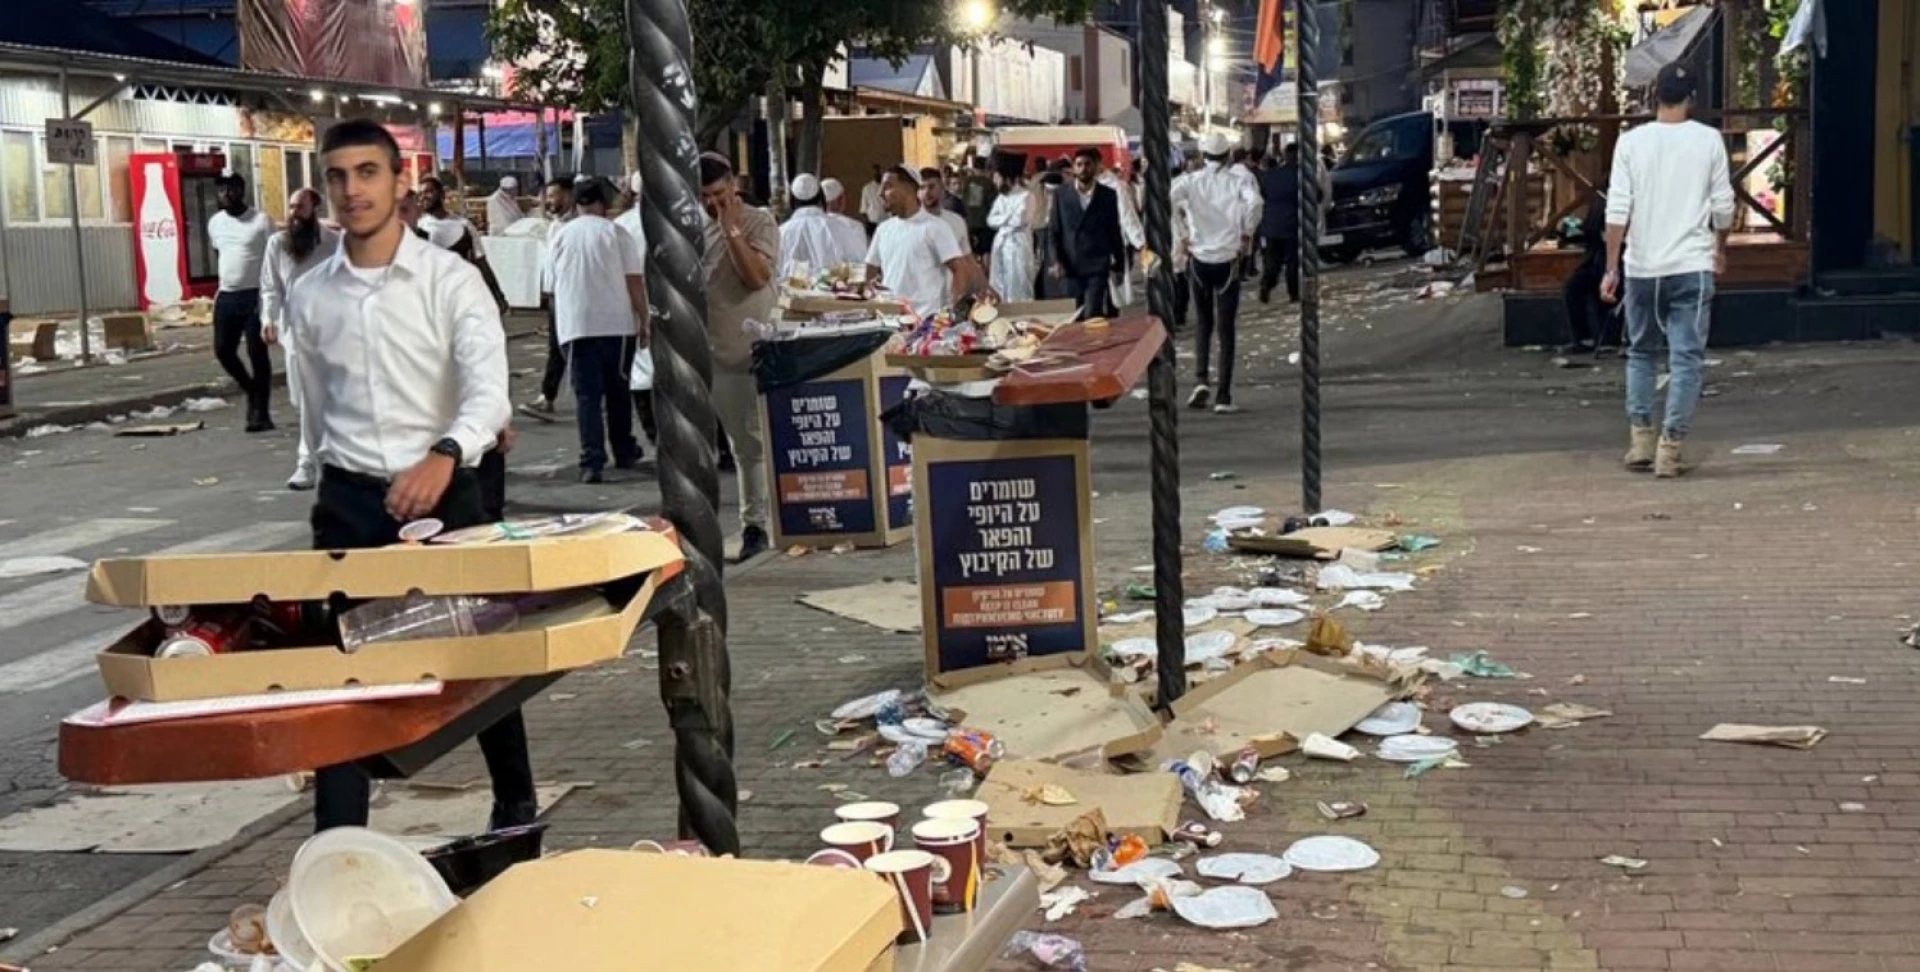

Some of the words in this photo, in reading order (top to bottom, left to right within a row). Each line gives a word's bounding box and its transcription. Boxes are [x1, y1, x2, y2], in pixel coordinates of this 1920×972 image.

[791, 395, 837, 413] שומרים
[791, 413, 822, 430] היופי
[823, 412, 841, 428] על
[799, 430, 836, 446] והפאר
[787, 448, 829, 468] הקיבוץ
[830, 445, 852, 461] של
[969, 478, 1036, 501] שומרים
[967, 503, 1014, 526] היופי
[1016, 501, 1040, 523] על
[978, 526, 1032, 549] והפאר
[959, 551, 1021, 578] הקיבוץ
[1024, 548, 1054, 569] של
